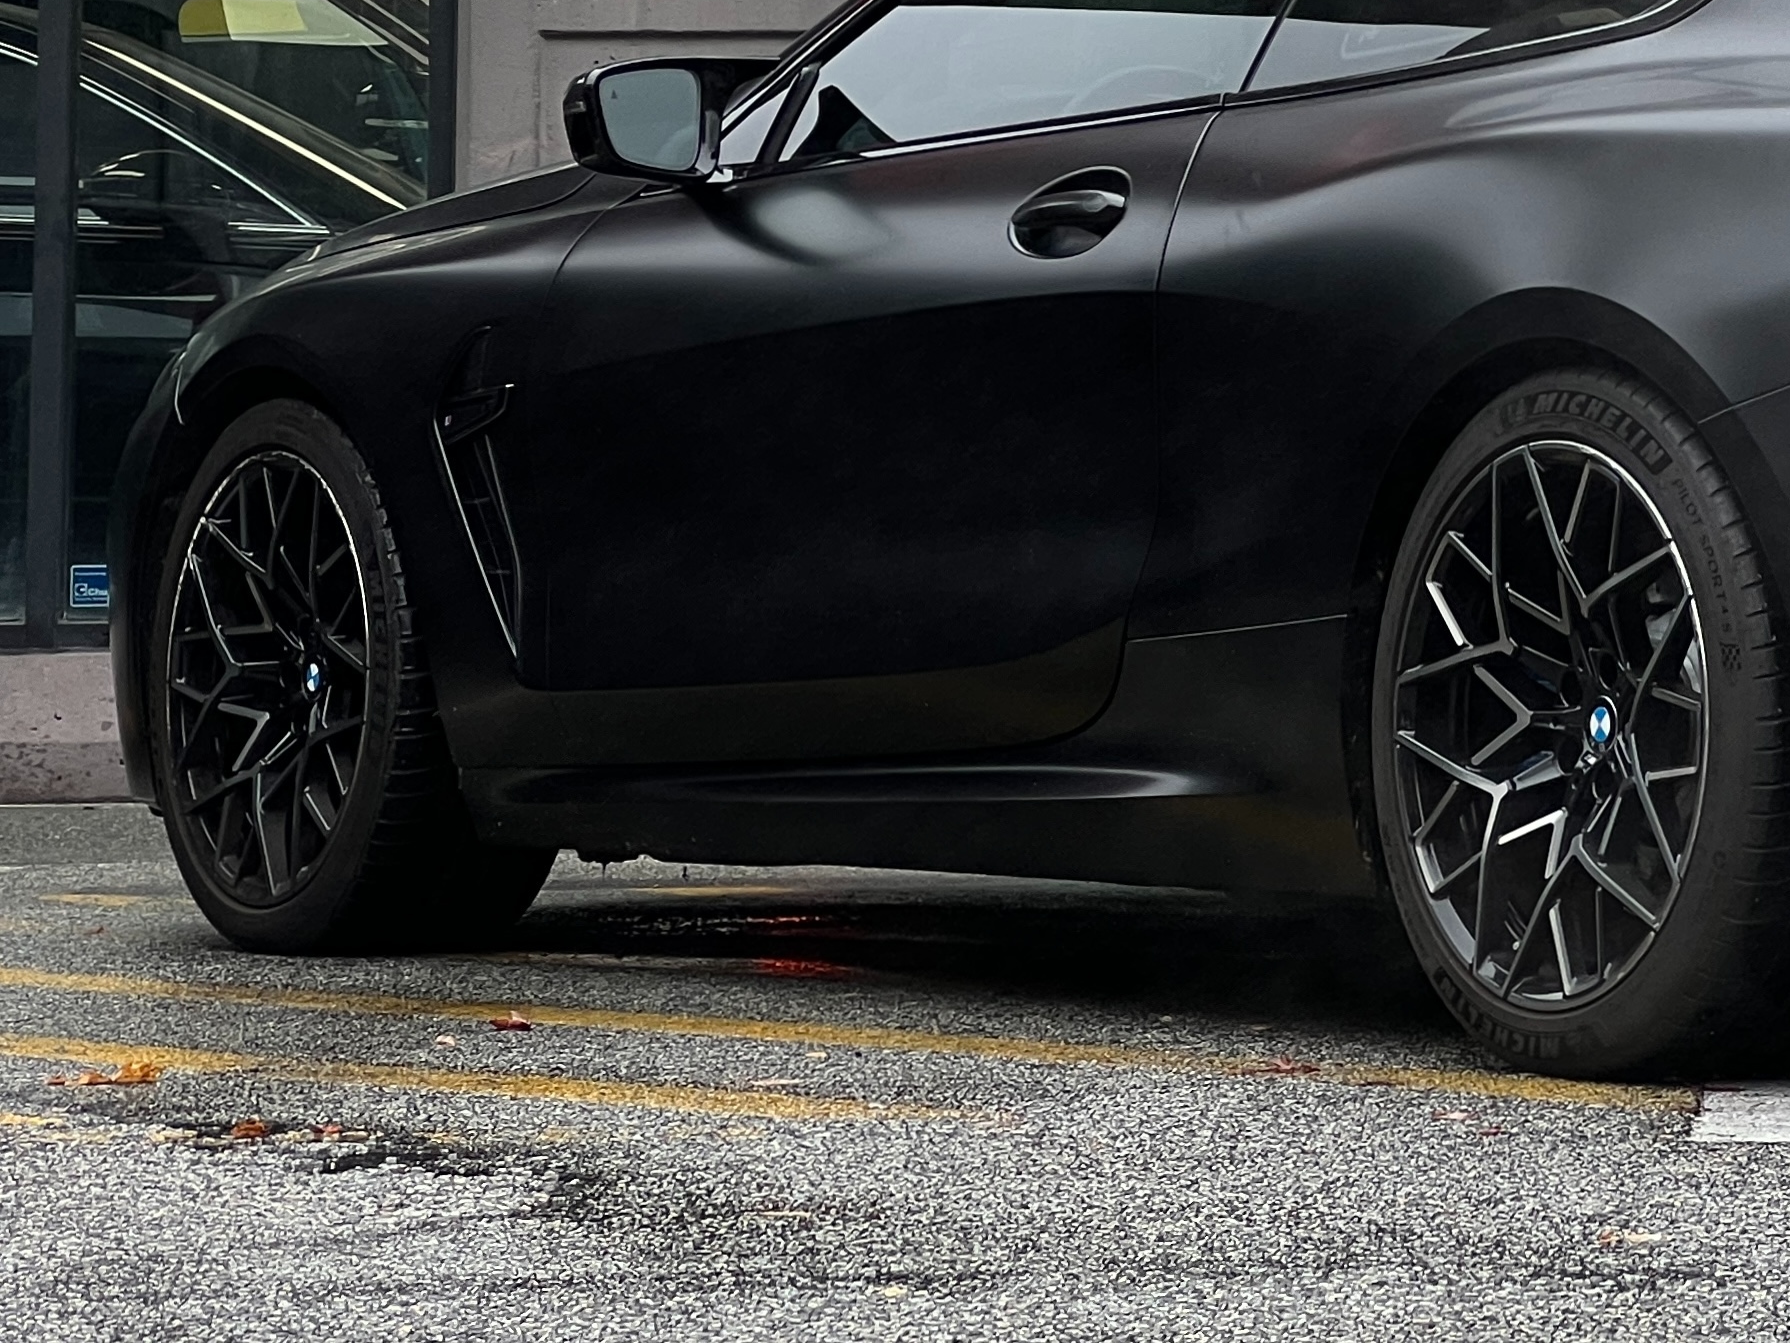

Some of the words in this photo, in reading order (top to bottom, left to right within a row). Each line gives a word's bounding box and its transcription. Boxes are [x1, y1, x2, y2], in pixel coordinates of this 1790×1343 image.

[1532, 392, 1665, 466] MICHELIN
[1672, 478, 1704, 526] PILOT
[1699, 534, 1728, 600] SPORT
